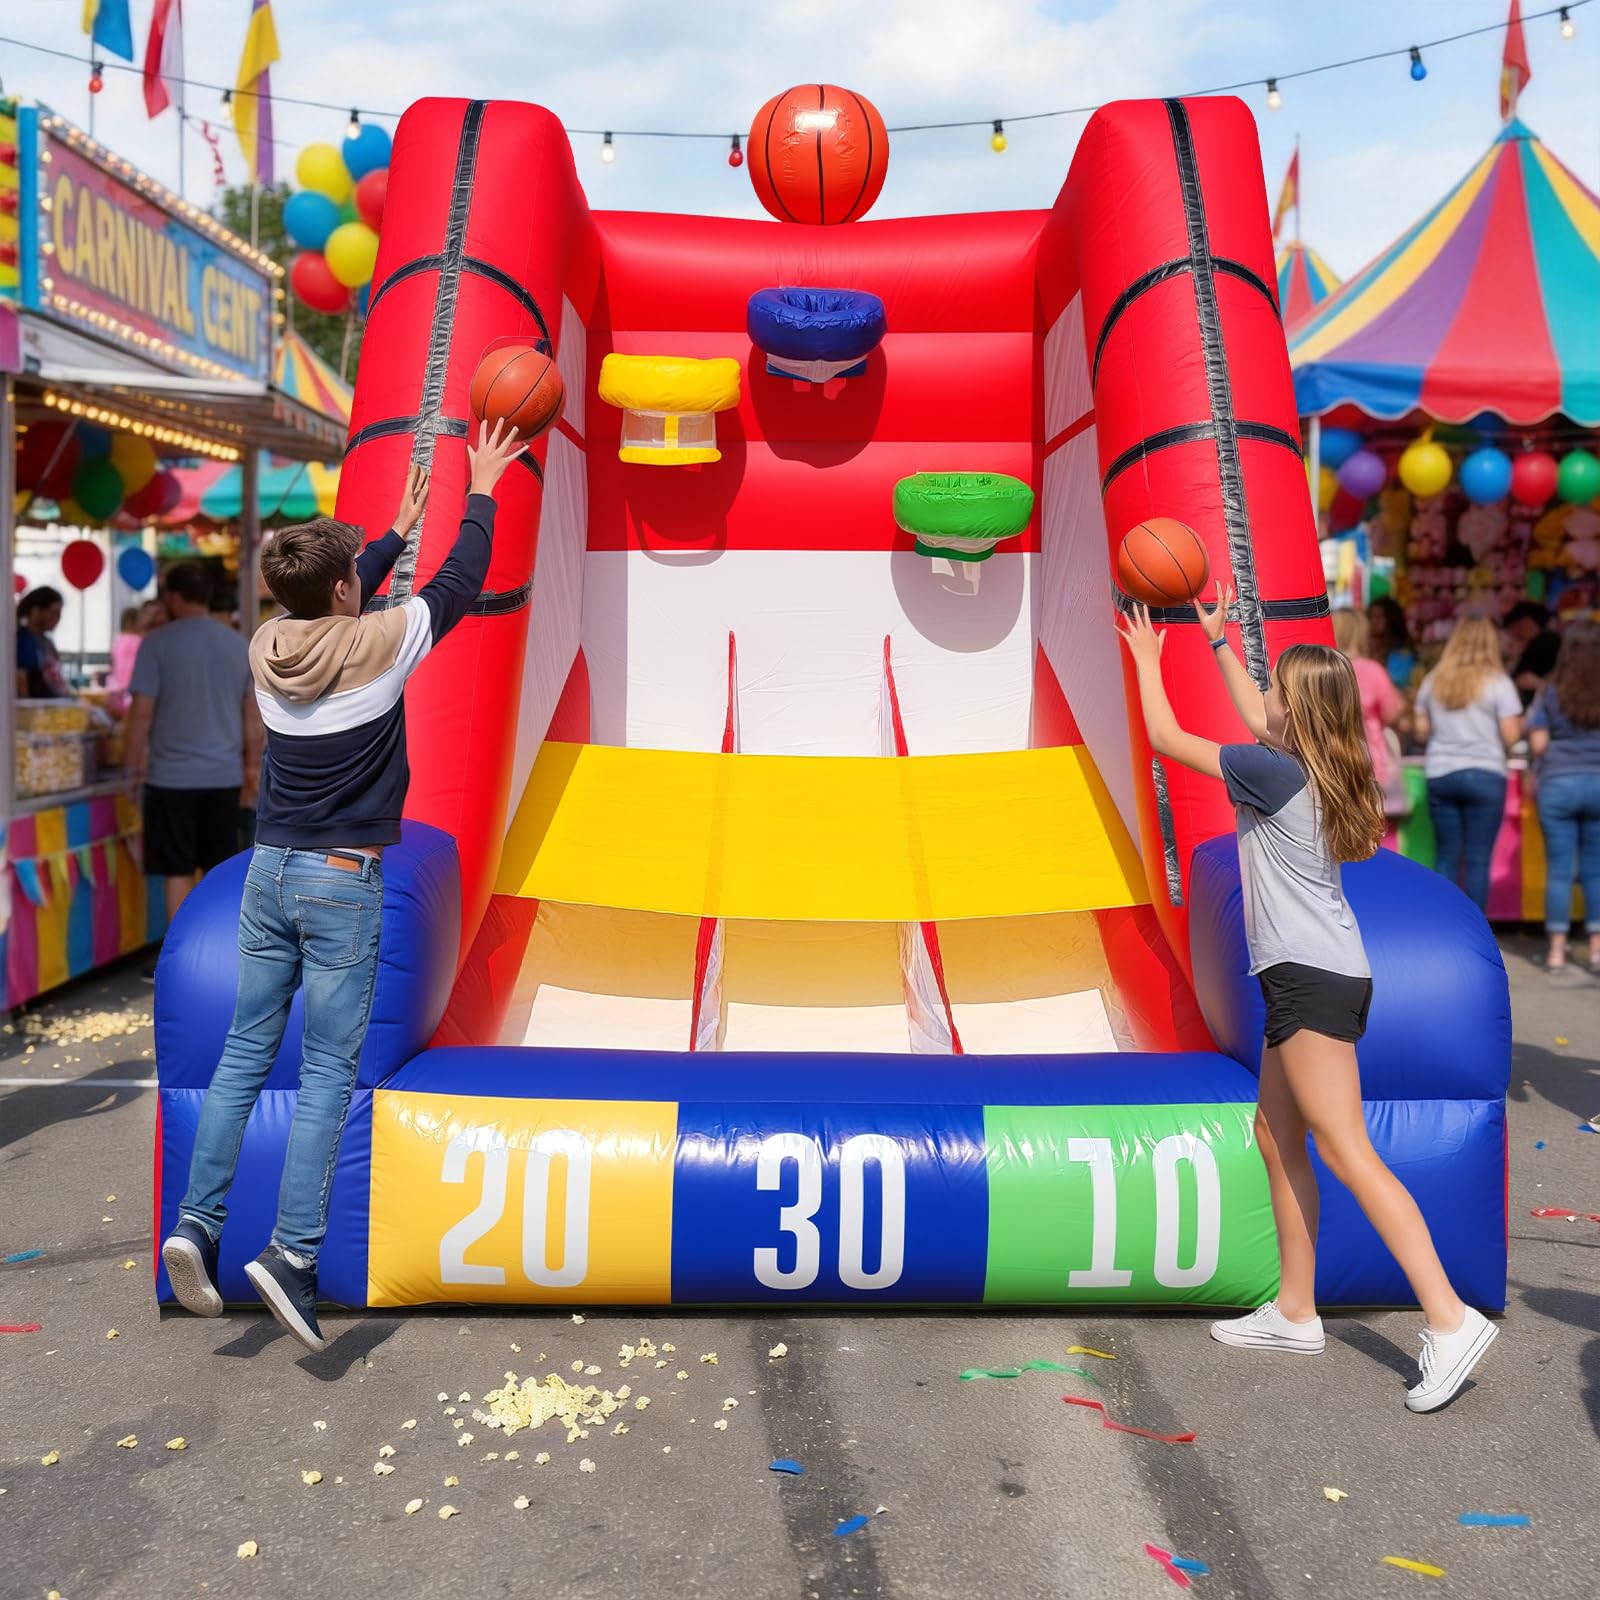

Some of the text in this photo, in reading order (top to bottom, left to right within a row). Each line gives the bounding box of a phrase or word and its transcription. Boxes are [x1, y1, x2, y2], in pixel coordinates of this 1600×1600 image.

[53, 174, 195, 334] CARNIVAL
[439, 1128, 592, 1288] 20
[753, 1132, 906, 1290] 30
[1067, 1135, 1221, 1288] 10
